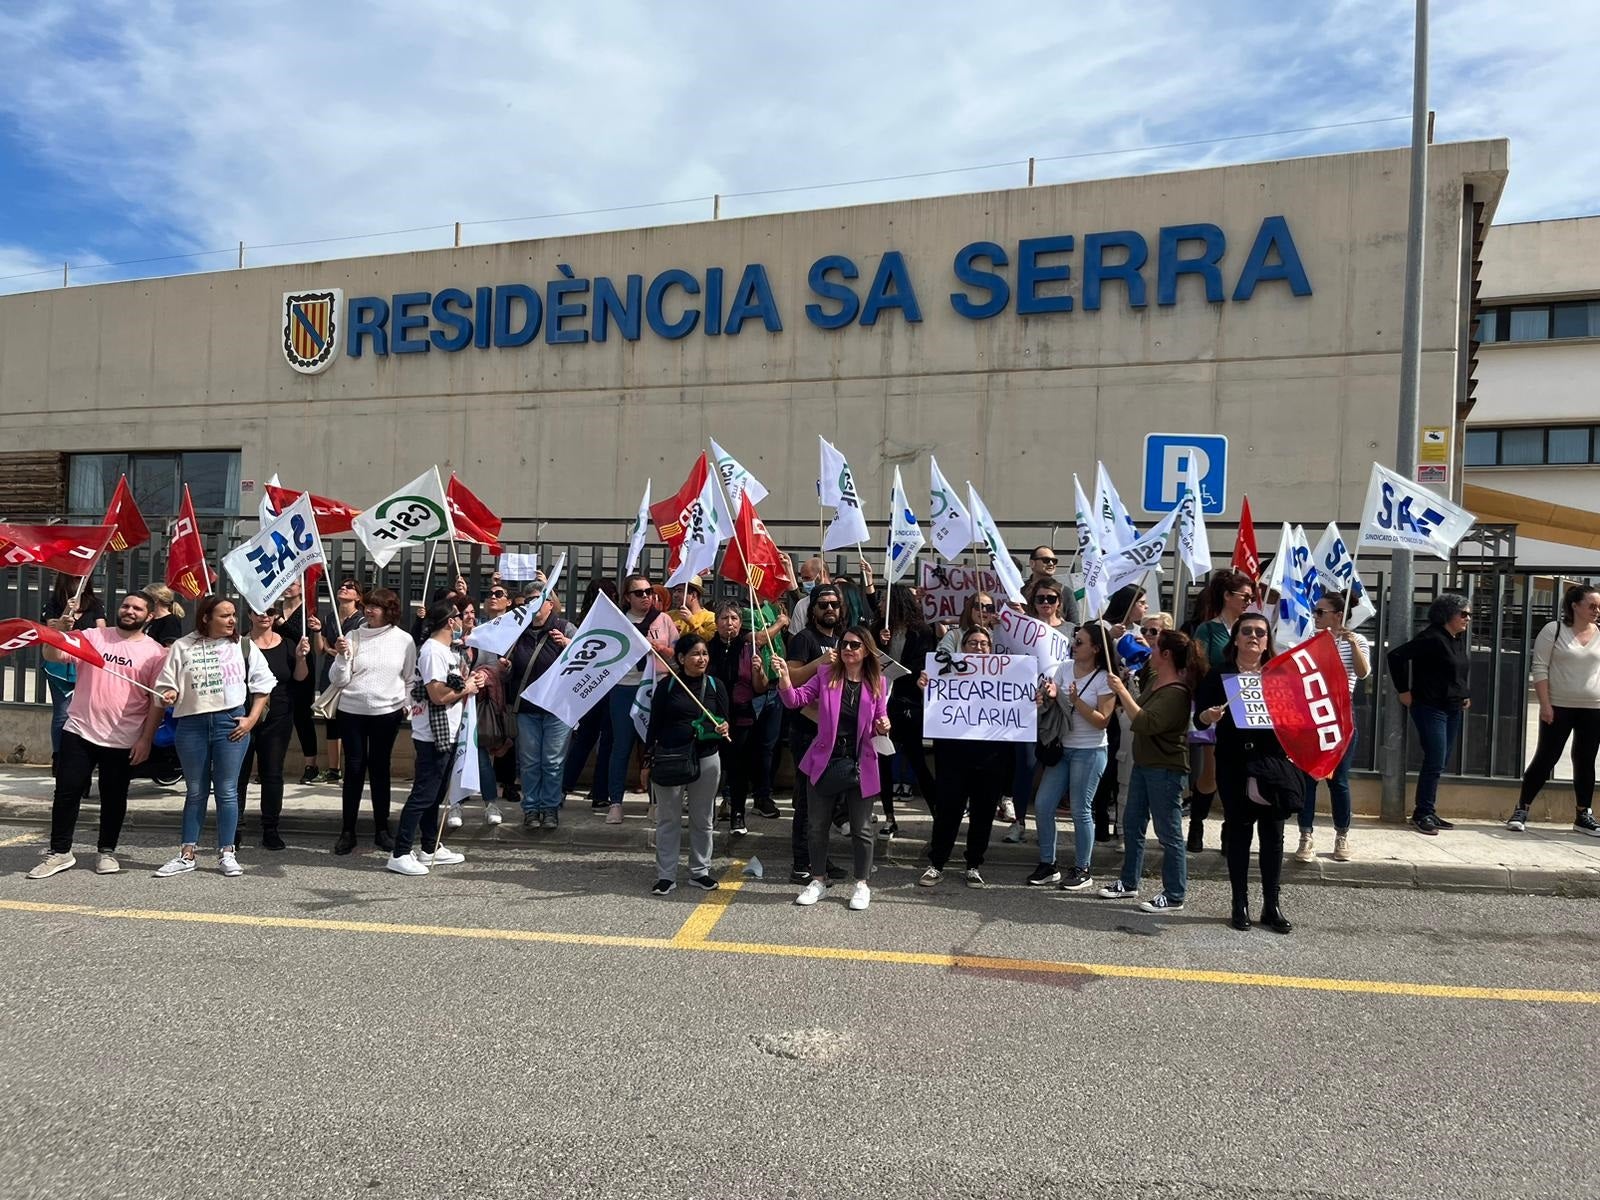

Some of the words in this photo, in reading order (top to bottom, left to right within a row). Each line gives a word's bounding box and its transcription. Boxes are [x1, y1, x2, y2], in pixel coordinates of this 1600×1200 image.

[346, 263, 784, 357] RESIDÈNCIA
[805, 250, 923, 331] SA
[949, 215, 1313, 321] SERRA
[1160, 445, 1211, 503] P
[1000, 610, 1047, 648] STOP
[103, 652, 133, 668] NASA
[954, 655, 1012, 677] STOP
[927, 678, 1037, 703] PRECARIEDAD
[1291, 649, 1343, 752] CCOO
[942, 704, 1029, 729] SALARIAL
